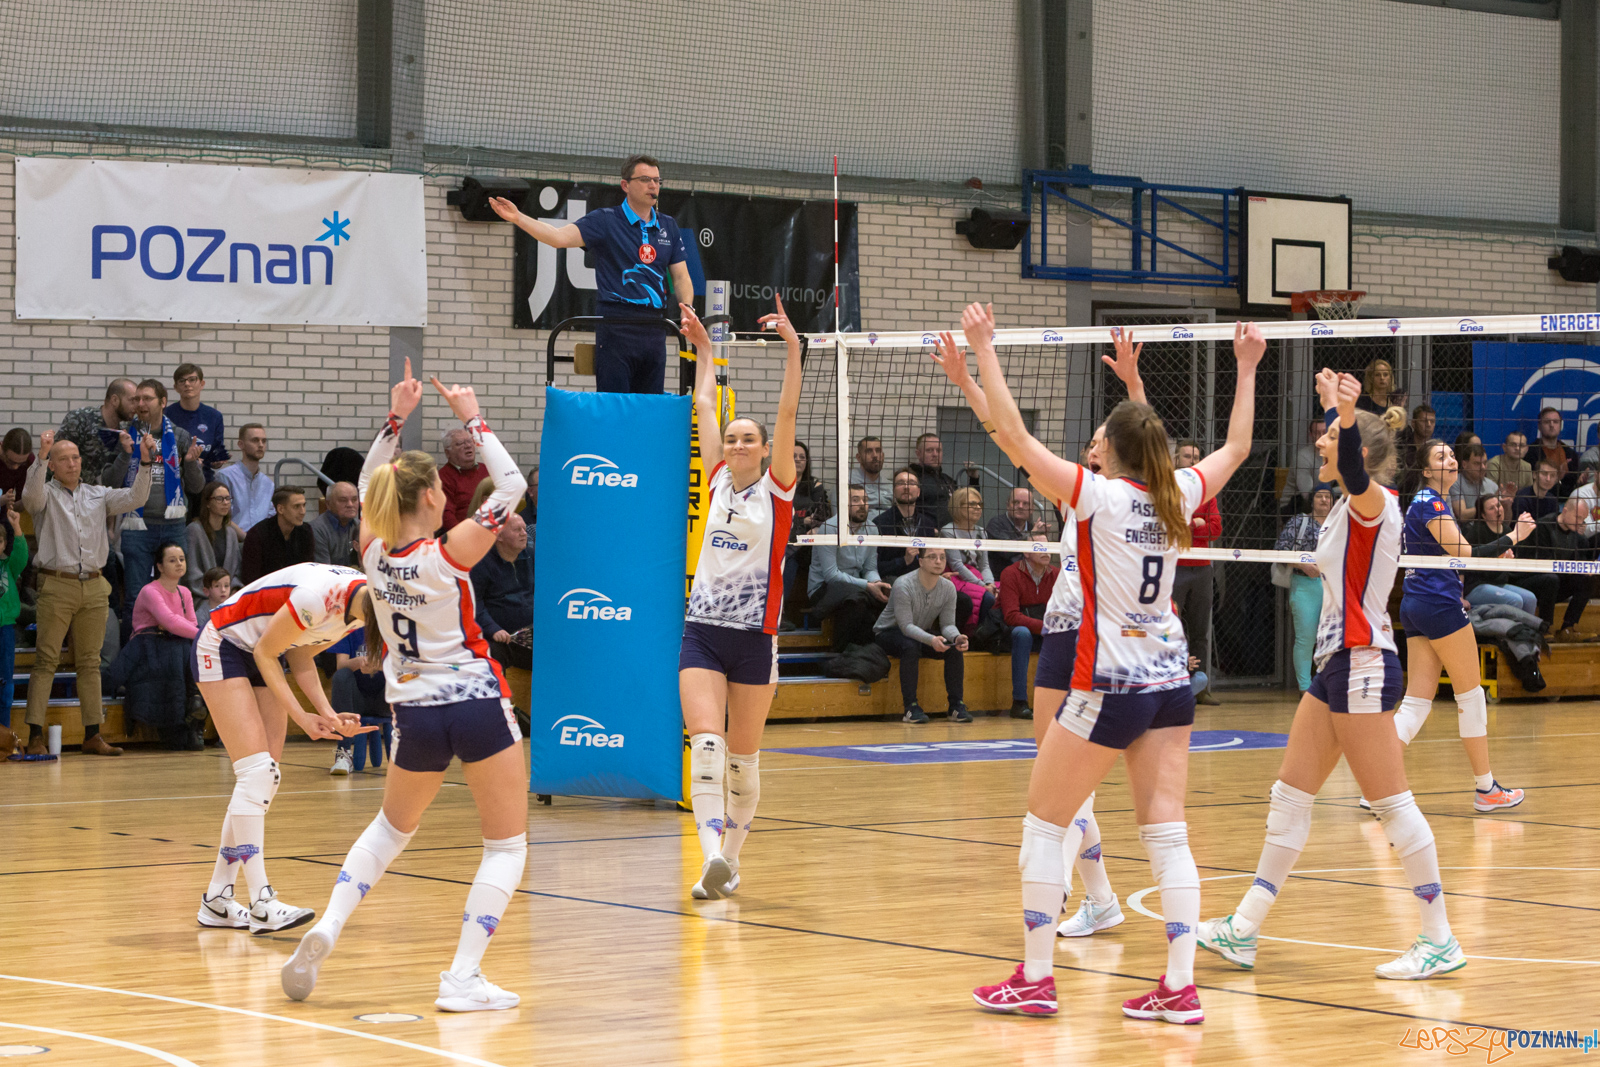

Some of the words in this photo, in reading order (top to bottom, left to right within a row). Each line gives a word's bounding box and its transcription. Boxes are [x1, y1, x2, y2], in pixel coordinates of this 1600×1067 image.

[730, 283, 826, 309] utsourcing
[1311, 328, 1334, 336] Enea
[1460, 324, 1484, 332] Enea
[1043, 334, 1064, 342] Enea
[571, 465, 638, 487] Enea
[711, 536, 748, 551] Enea
[1126, 529, 1167, 545] ENERGET
[1552, 561, 1600, 573] ENERGETY
[1138, 556, 1163, 604] 8
[567, 600, 632, 621] Enea
[392, 612, 420, 658] 9
[204, 655, 213, 670] 5
[560, 726, 625, 748] Enea
